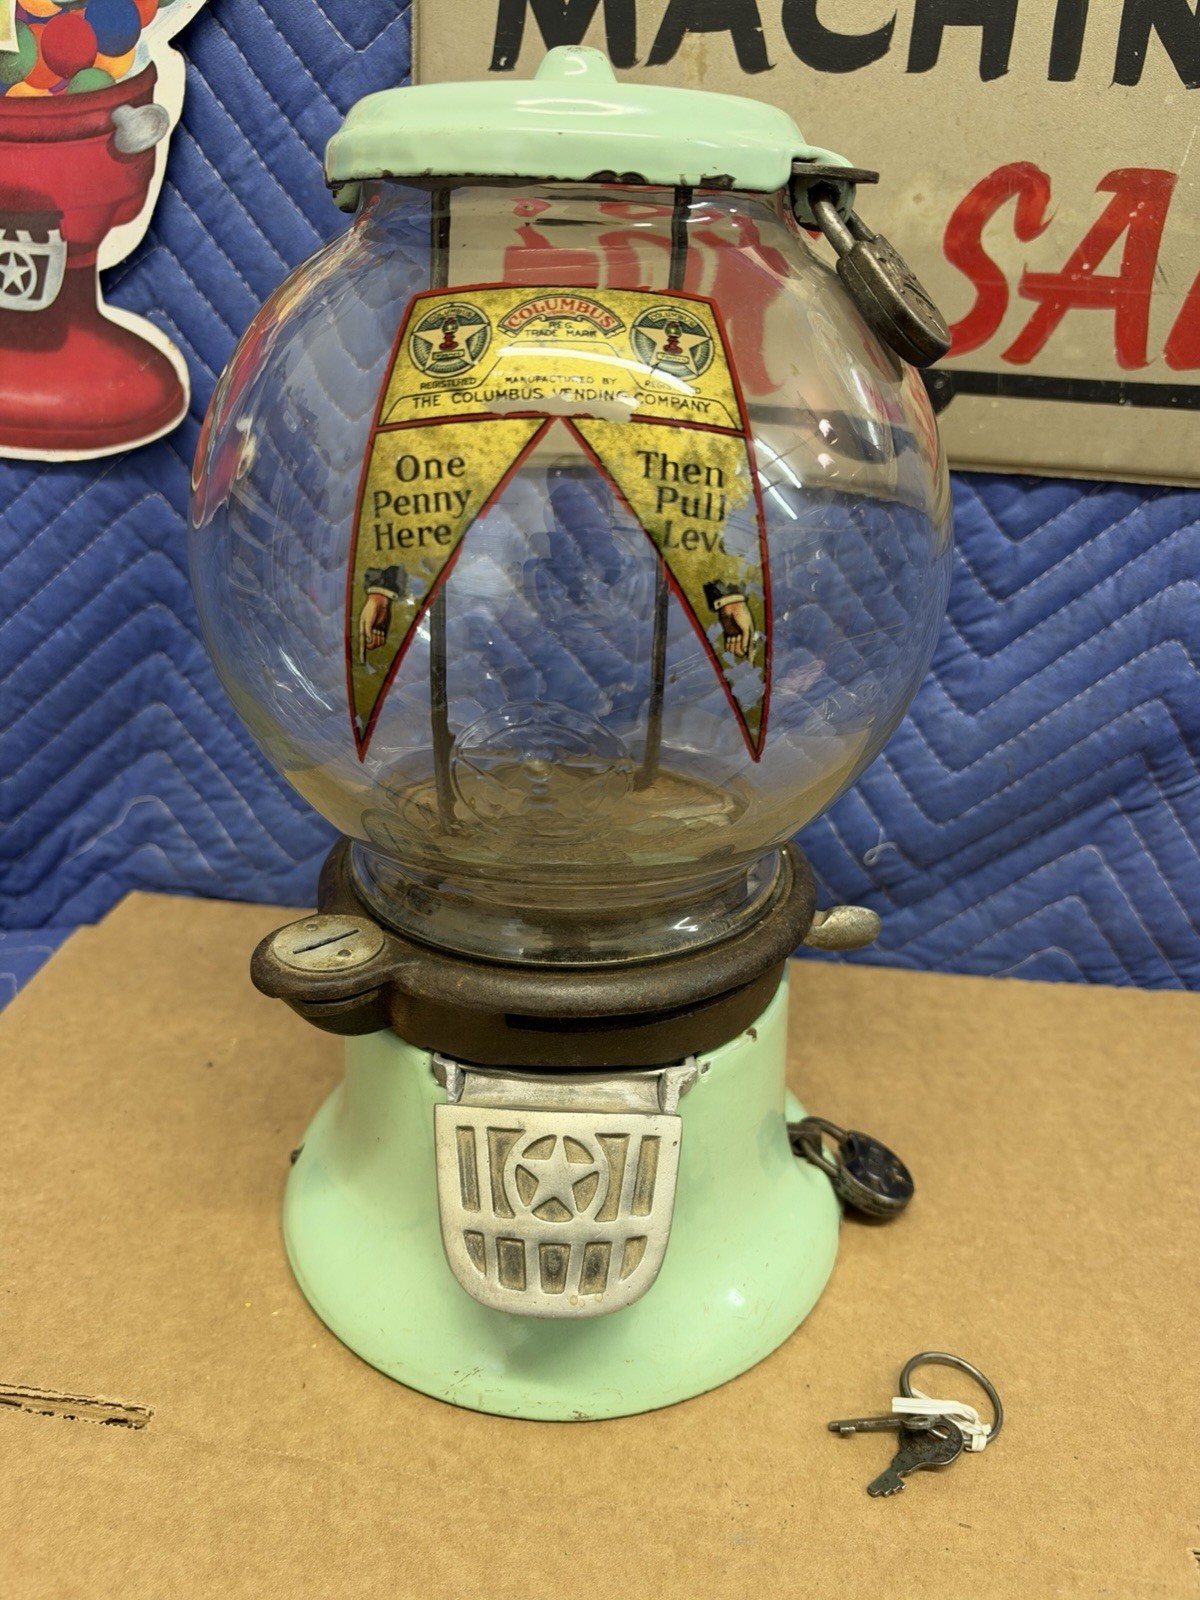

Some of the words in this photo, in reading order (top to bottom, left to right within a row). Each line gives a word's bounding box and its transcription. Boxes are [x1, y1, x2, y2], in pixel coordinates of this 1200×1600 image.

[507, 298, 617, 328] COLUMBUS
[525, 329, 558, 338] TRADE
[566, 330, 597, 338] MARK
[420, 377, 477, 391] REGISTERED
[602, 377, 617, 385] BY
[412, 395, 441, 409] THE
[451, 388, 544, 404] COLUMBUS
[634, 392, 711, 413] COMPANY
[395, 454, 466, 482] One
[636, 450, 724, 488] Then
[373, 489, 473, 519] Penny
[656, 486, 726, 522] Pull
[373, 523, 452, 552] Here
